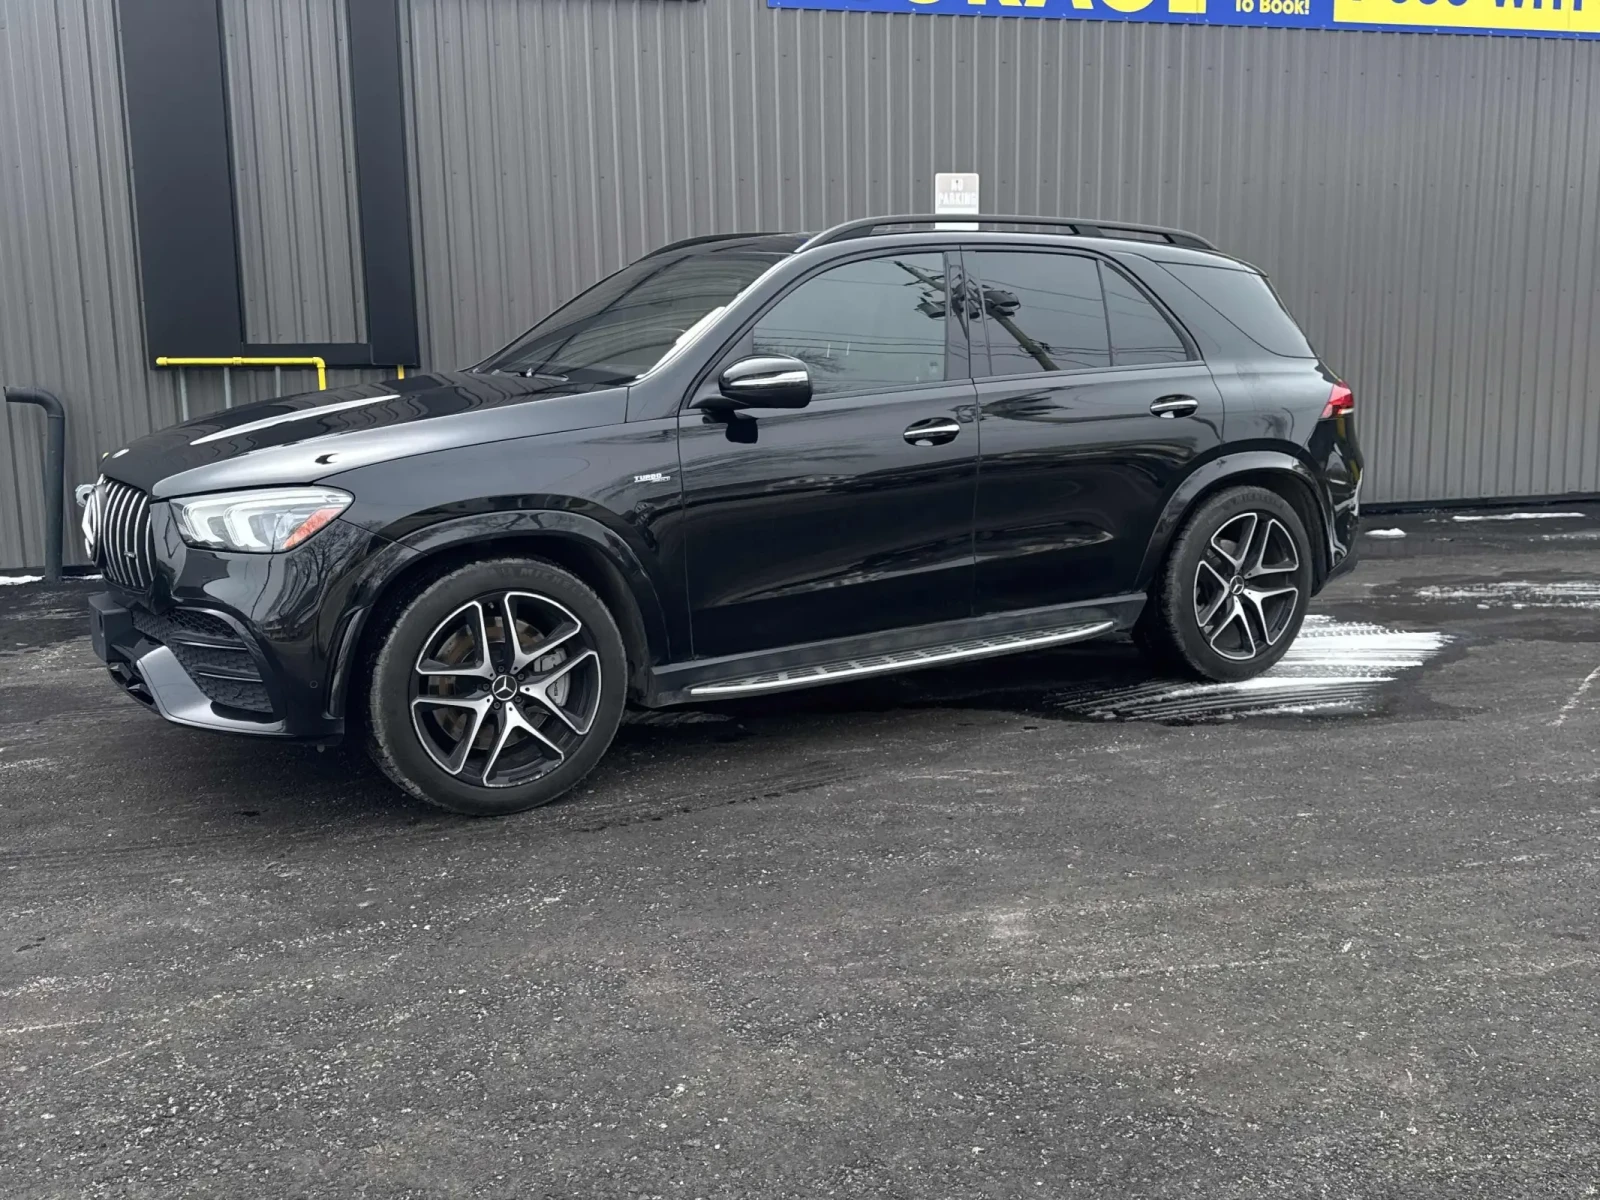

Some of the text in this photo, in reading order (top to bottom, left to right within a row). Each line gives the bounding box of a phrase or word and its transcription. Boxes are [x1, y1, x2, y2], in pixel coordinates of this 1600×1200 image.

[1259, 0, 1310, 15] Book!
[951, 178, 964, 192] NO
[938, 191, 977, 205] PARKING
[634, 473, 662, 482] TURBO
